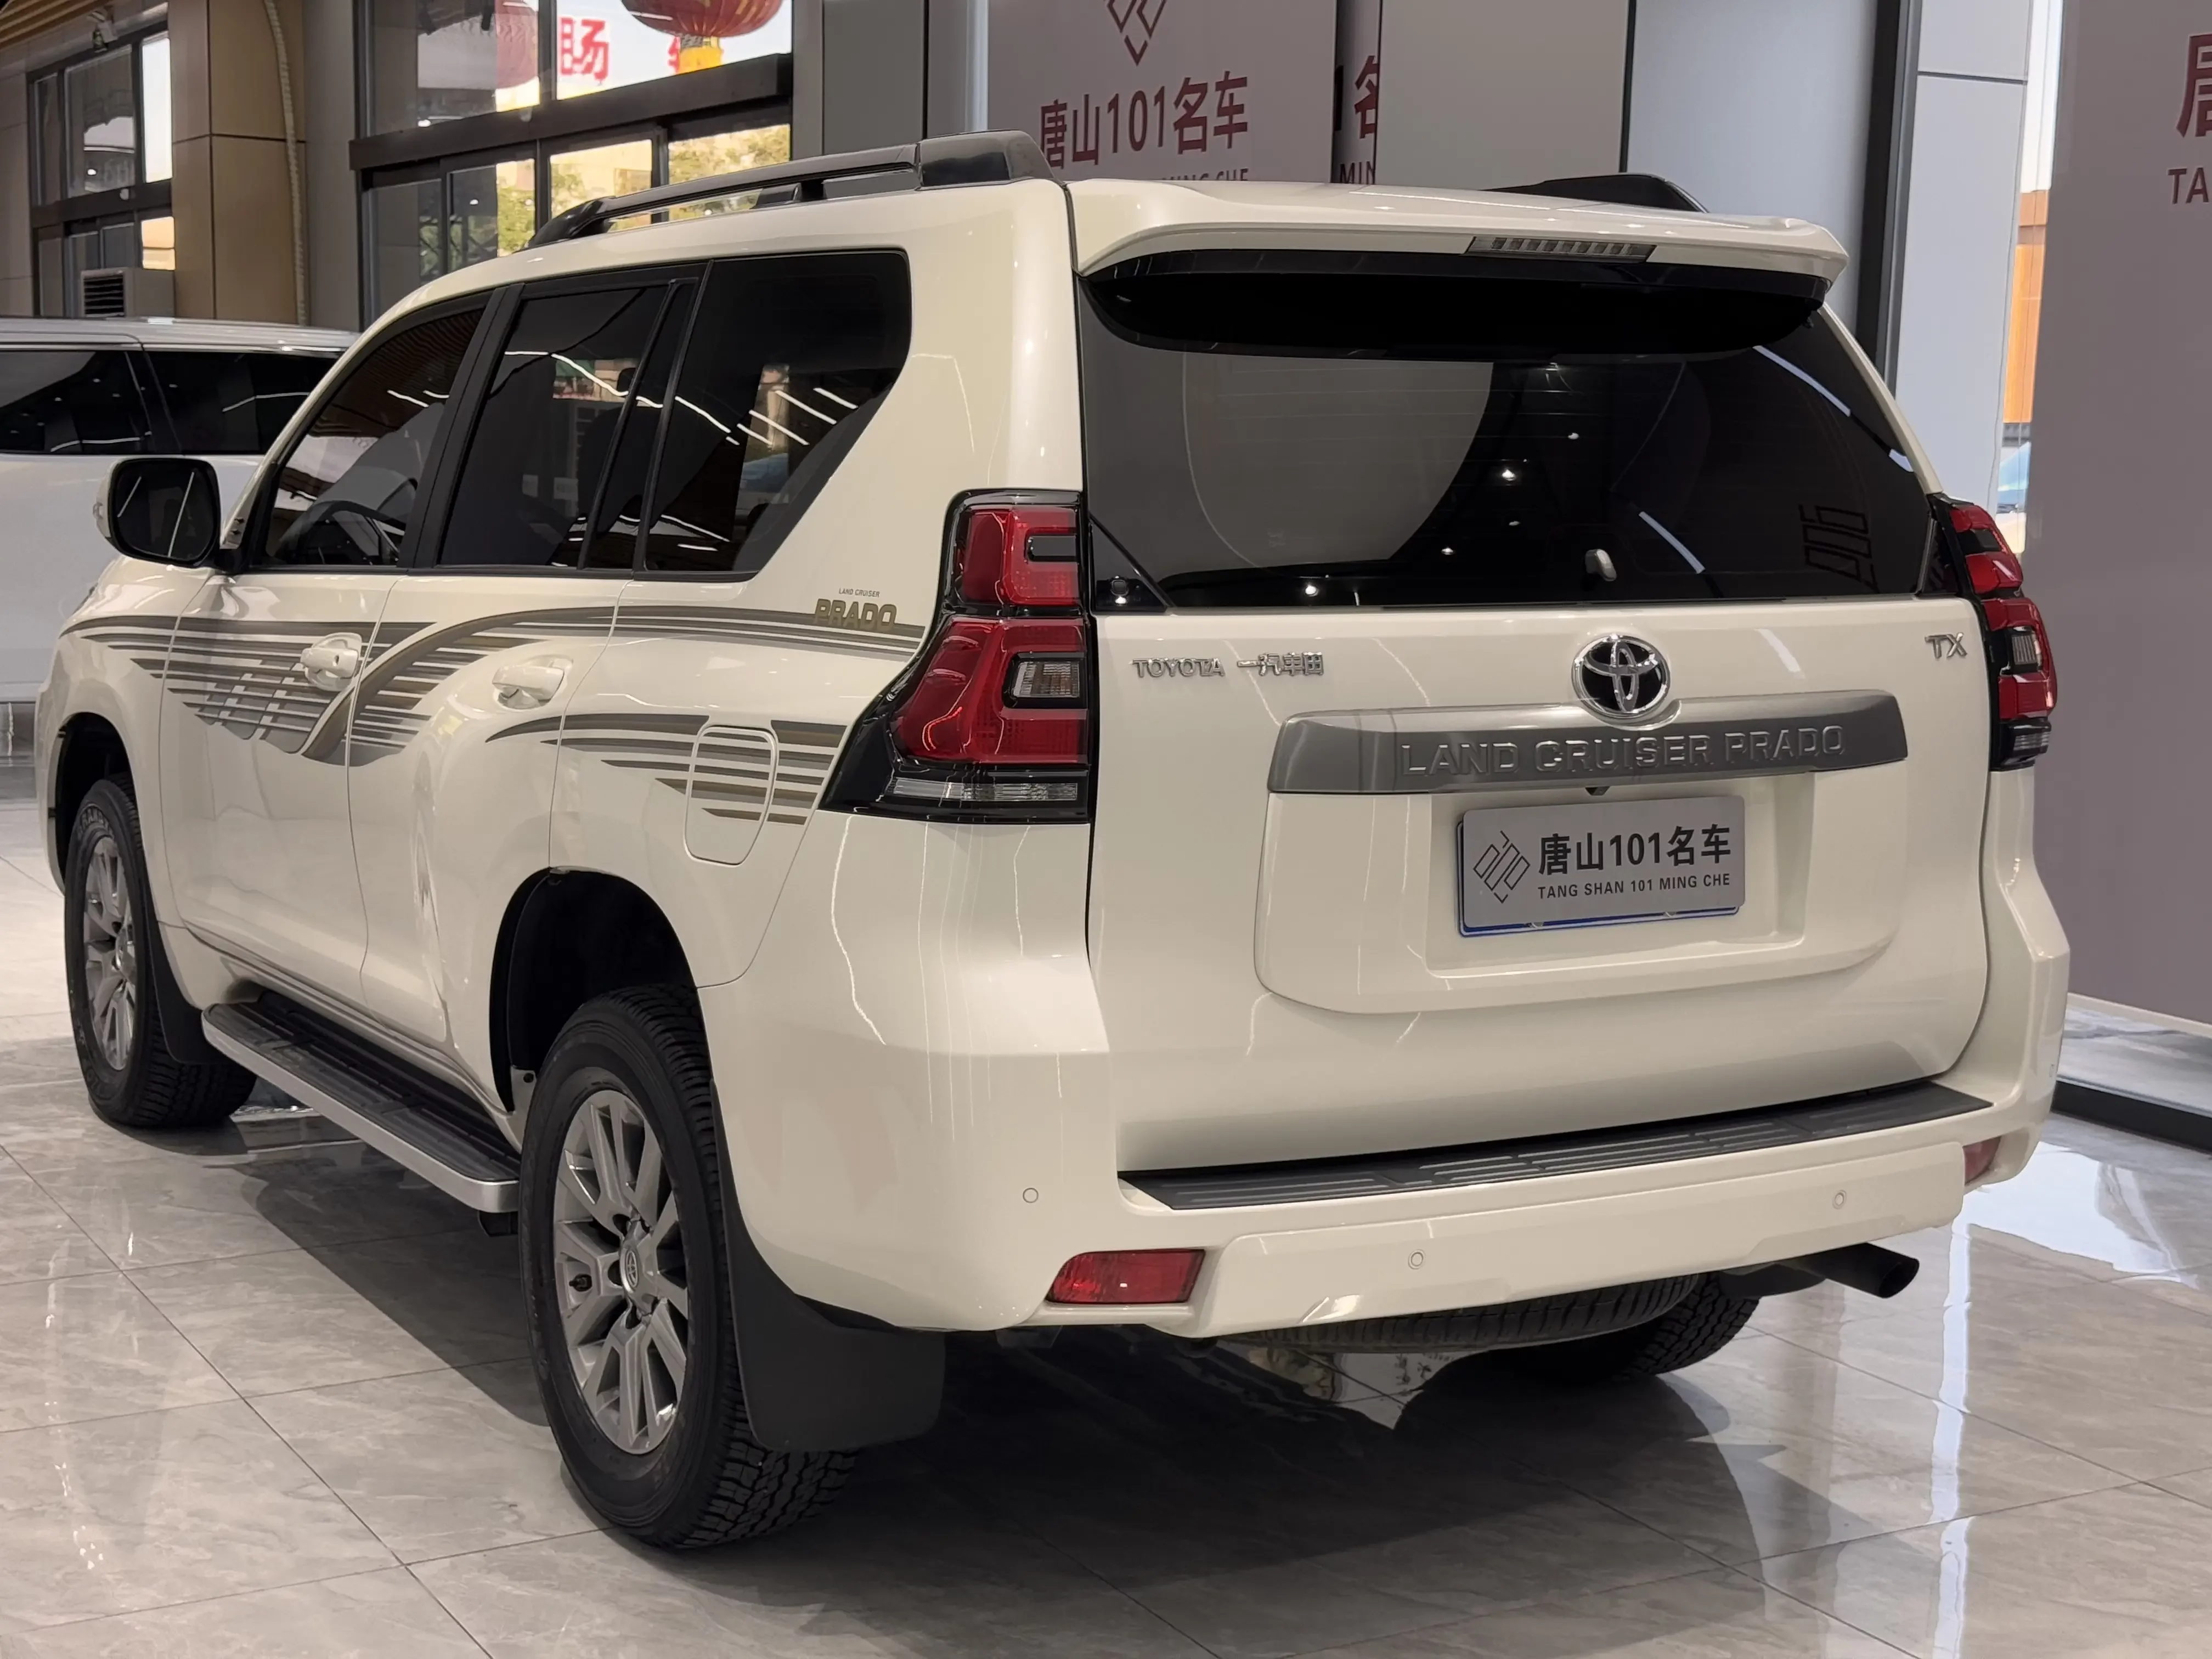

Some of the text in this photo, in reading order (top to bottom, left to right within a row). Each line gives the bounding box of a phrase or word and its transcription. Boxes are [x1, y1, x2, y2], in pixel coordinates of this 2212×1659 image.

[1041, 71, 1248, 169] 唐山101名车
[2168, 167, 2209, 204] TA
[855, 589, 881, 597] CRUISER
[813, 598, 897, 631] PRADO
[1924, 632, 1968, 658] TX
[1132, 657, 1226, 678] TOYOTA
[1402, 725, 1844, 776] LAND CRUISER PRADO
[1538, 824, 1731, 876] 唐山101名车
[1538, 873, 1731, 899] TANG SHAN 101 MING CHE
